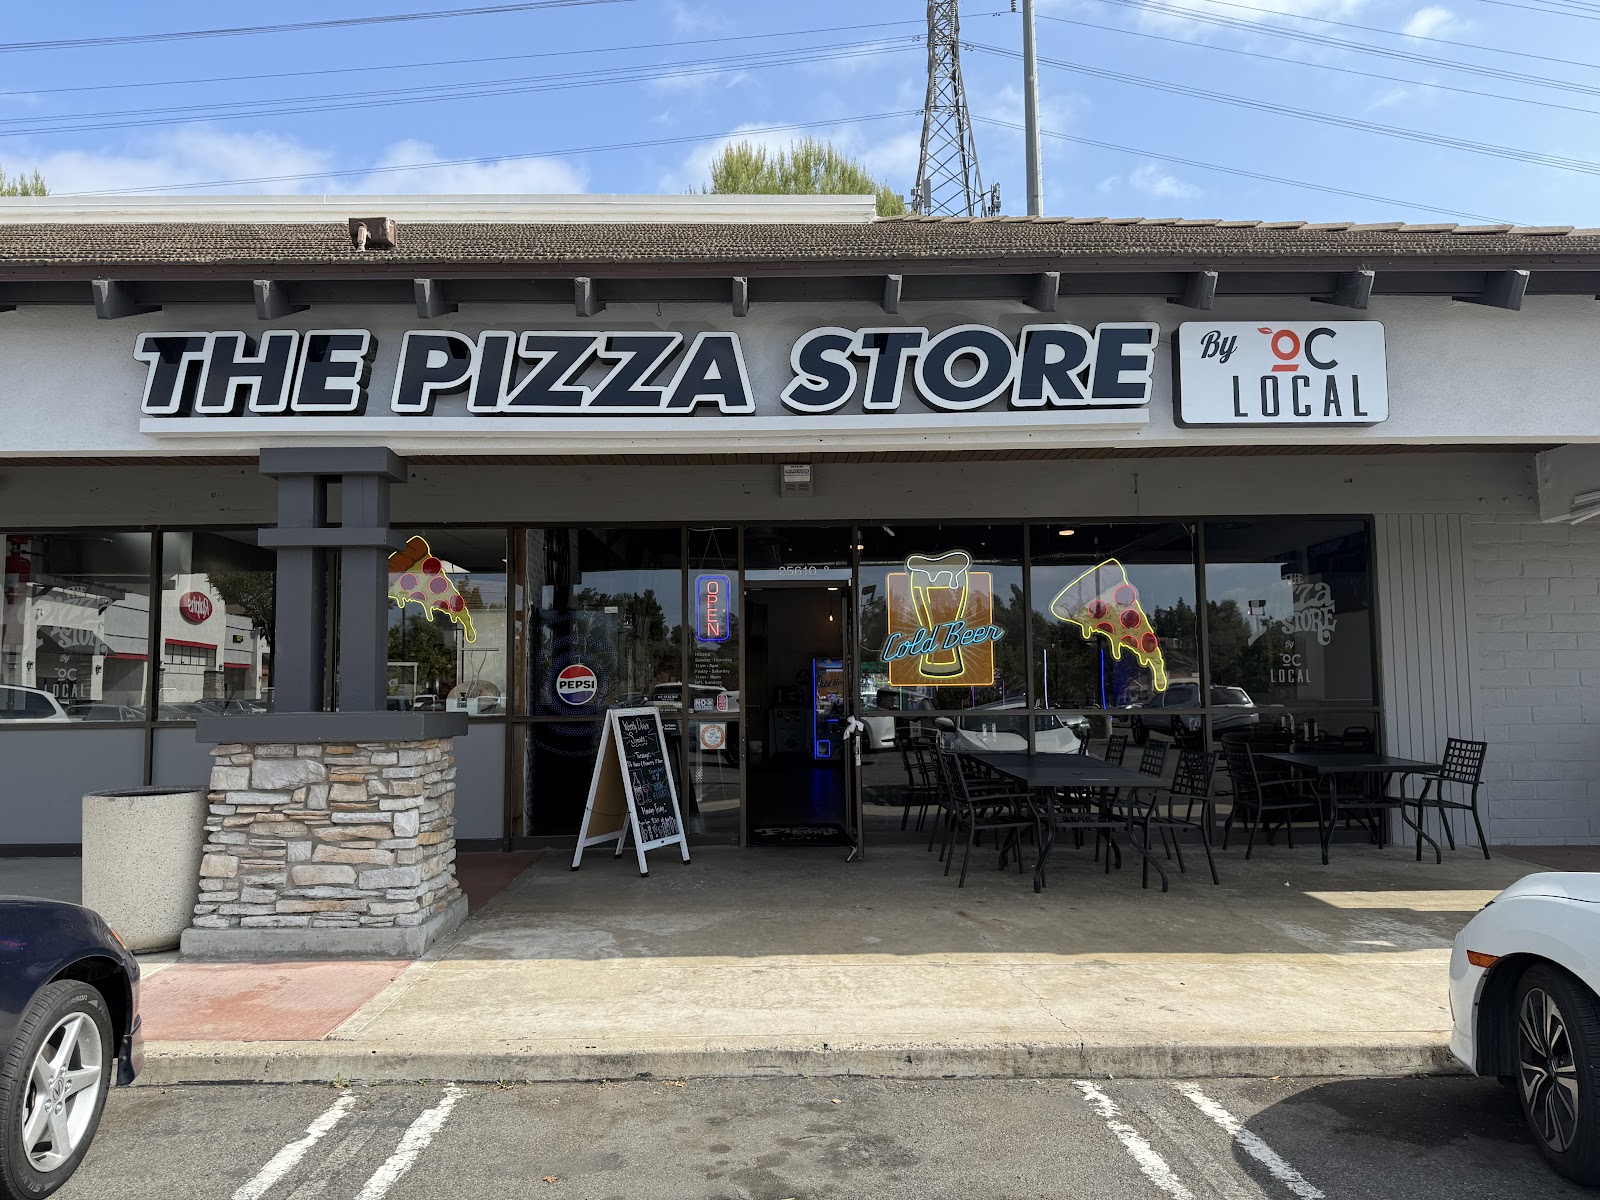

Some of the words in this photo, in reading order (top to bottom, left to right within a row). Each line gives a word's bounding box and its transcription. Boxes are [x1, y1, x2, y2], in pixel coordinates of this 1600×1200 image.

[1200, 330, 1238, 364] By
[1271, 327, 1339, 372] OC
[134, 329, 374, 415] THE
[391, 329, 756, 414] PIZZA
[780, 322, 1160, 413] STORE
[1232, 375, 1368, 417] LOCAL
[779, 566, 817, 576] 25610
[707, 581, 720, 637] OPEN
[1281, 603, 1338, 646] STORE
[883, 625, 938, 661] Cold
[941, 620, 1006, 650] Beer
[1284, 640, 1295, 649] By
[60, 654, 70, 663] By
[559, 680, 595, 689] PEPSI
[1270, 669, 1312, 683] LOCAL
[44, 684, 86, 698] LOCAL
